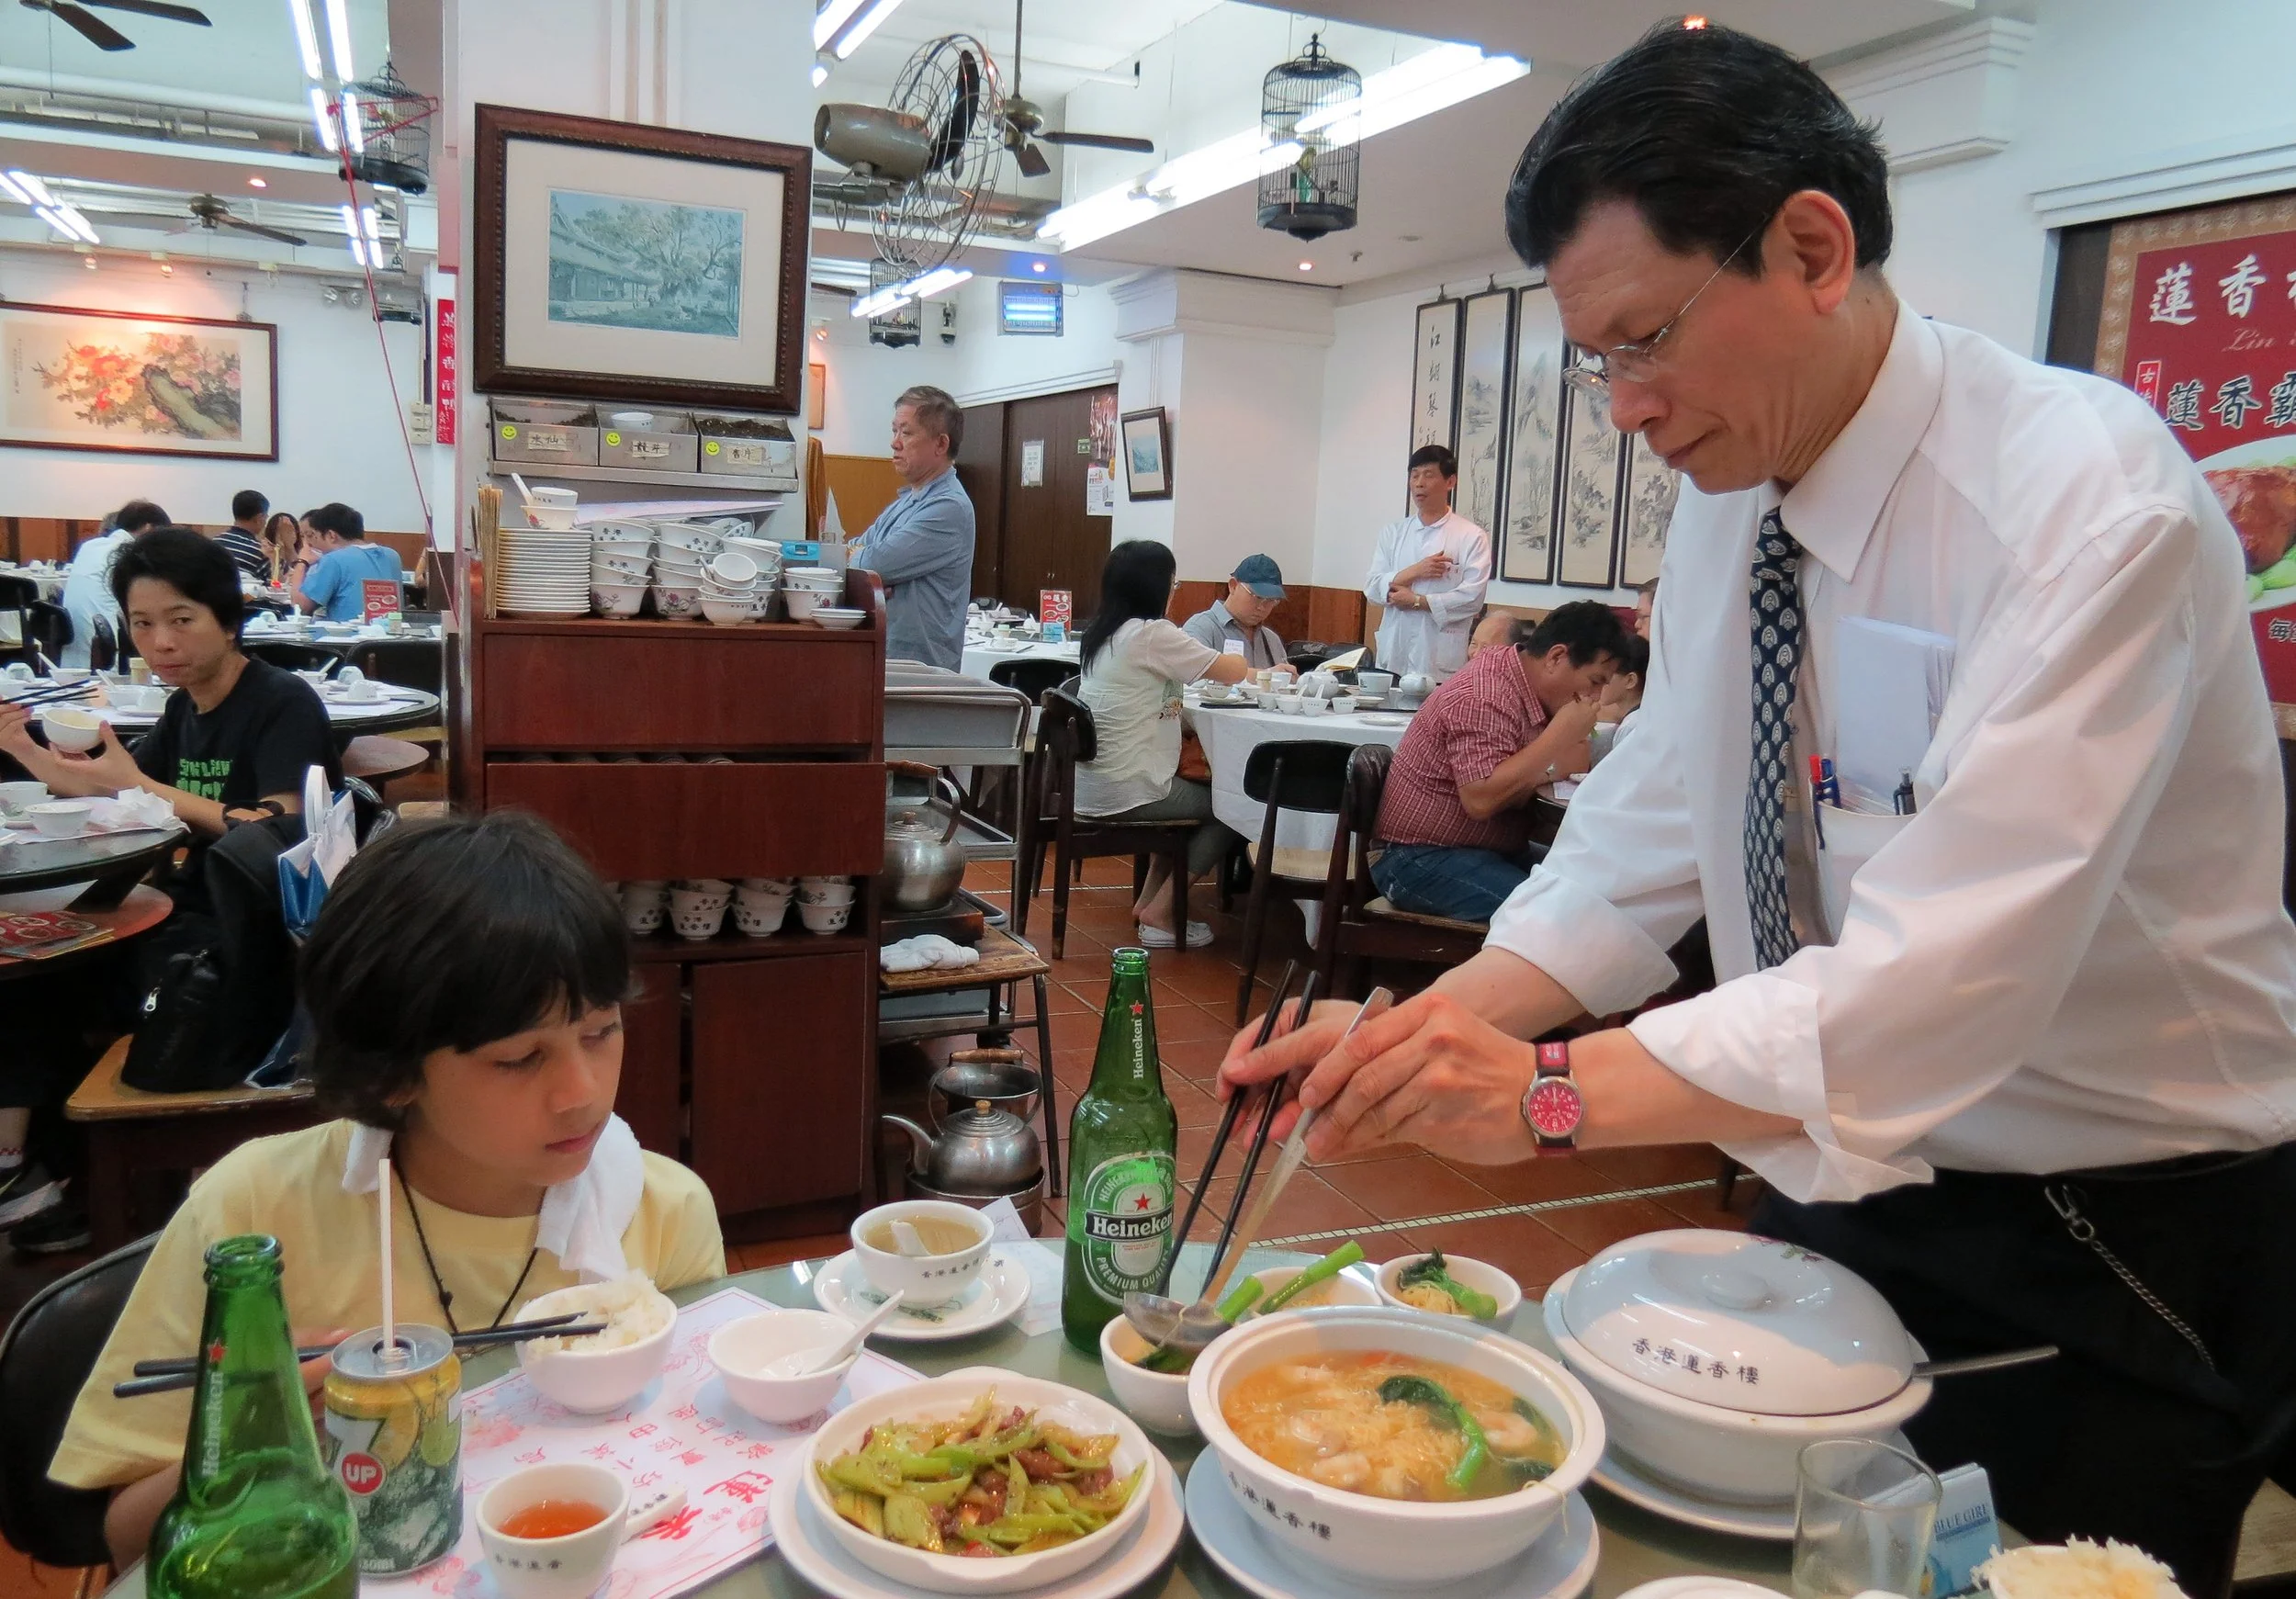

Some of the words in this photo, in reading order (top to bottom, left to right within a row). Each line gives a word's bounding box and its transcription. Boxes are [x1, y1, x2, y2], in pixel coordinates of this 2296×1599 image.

[2149, 253, 2296, 326] 蓮香
[2222, 327, 2278, 352] Lin
[531, 434, 559, 446] 水仙
[1132, 1018, 1144, 1078] Heineken
[1093, 1211, 1174, 1238] Heineken
[1097, 1256, 1140, 1290] PREMIUM
[1142, 1249, 1169, 1288] QUALITY
[1632, 1337, 1760, 1385] 香港蓮香樓
[345, 1462, 377, 1484] UP
[1933, 1515, 1963, 1534] BLUE
[1963, 1503, 1987, 1524] GIRL
